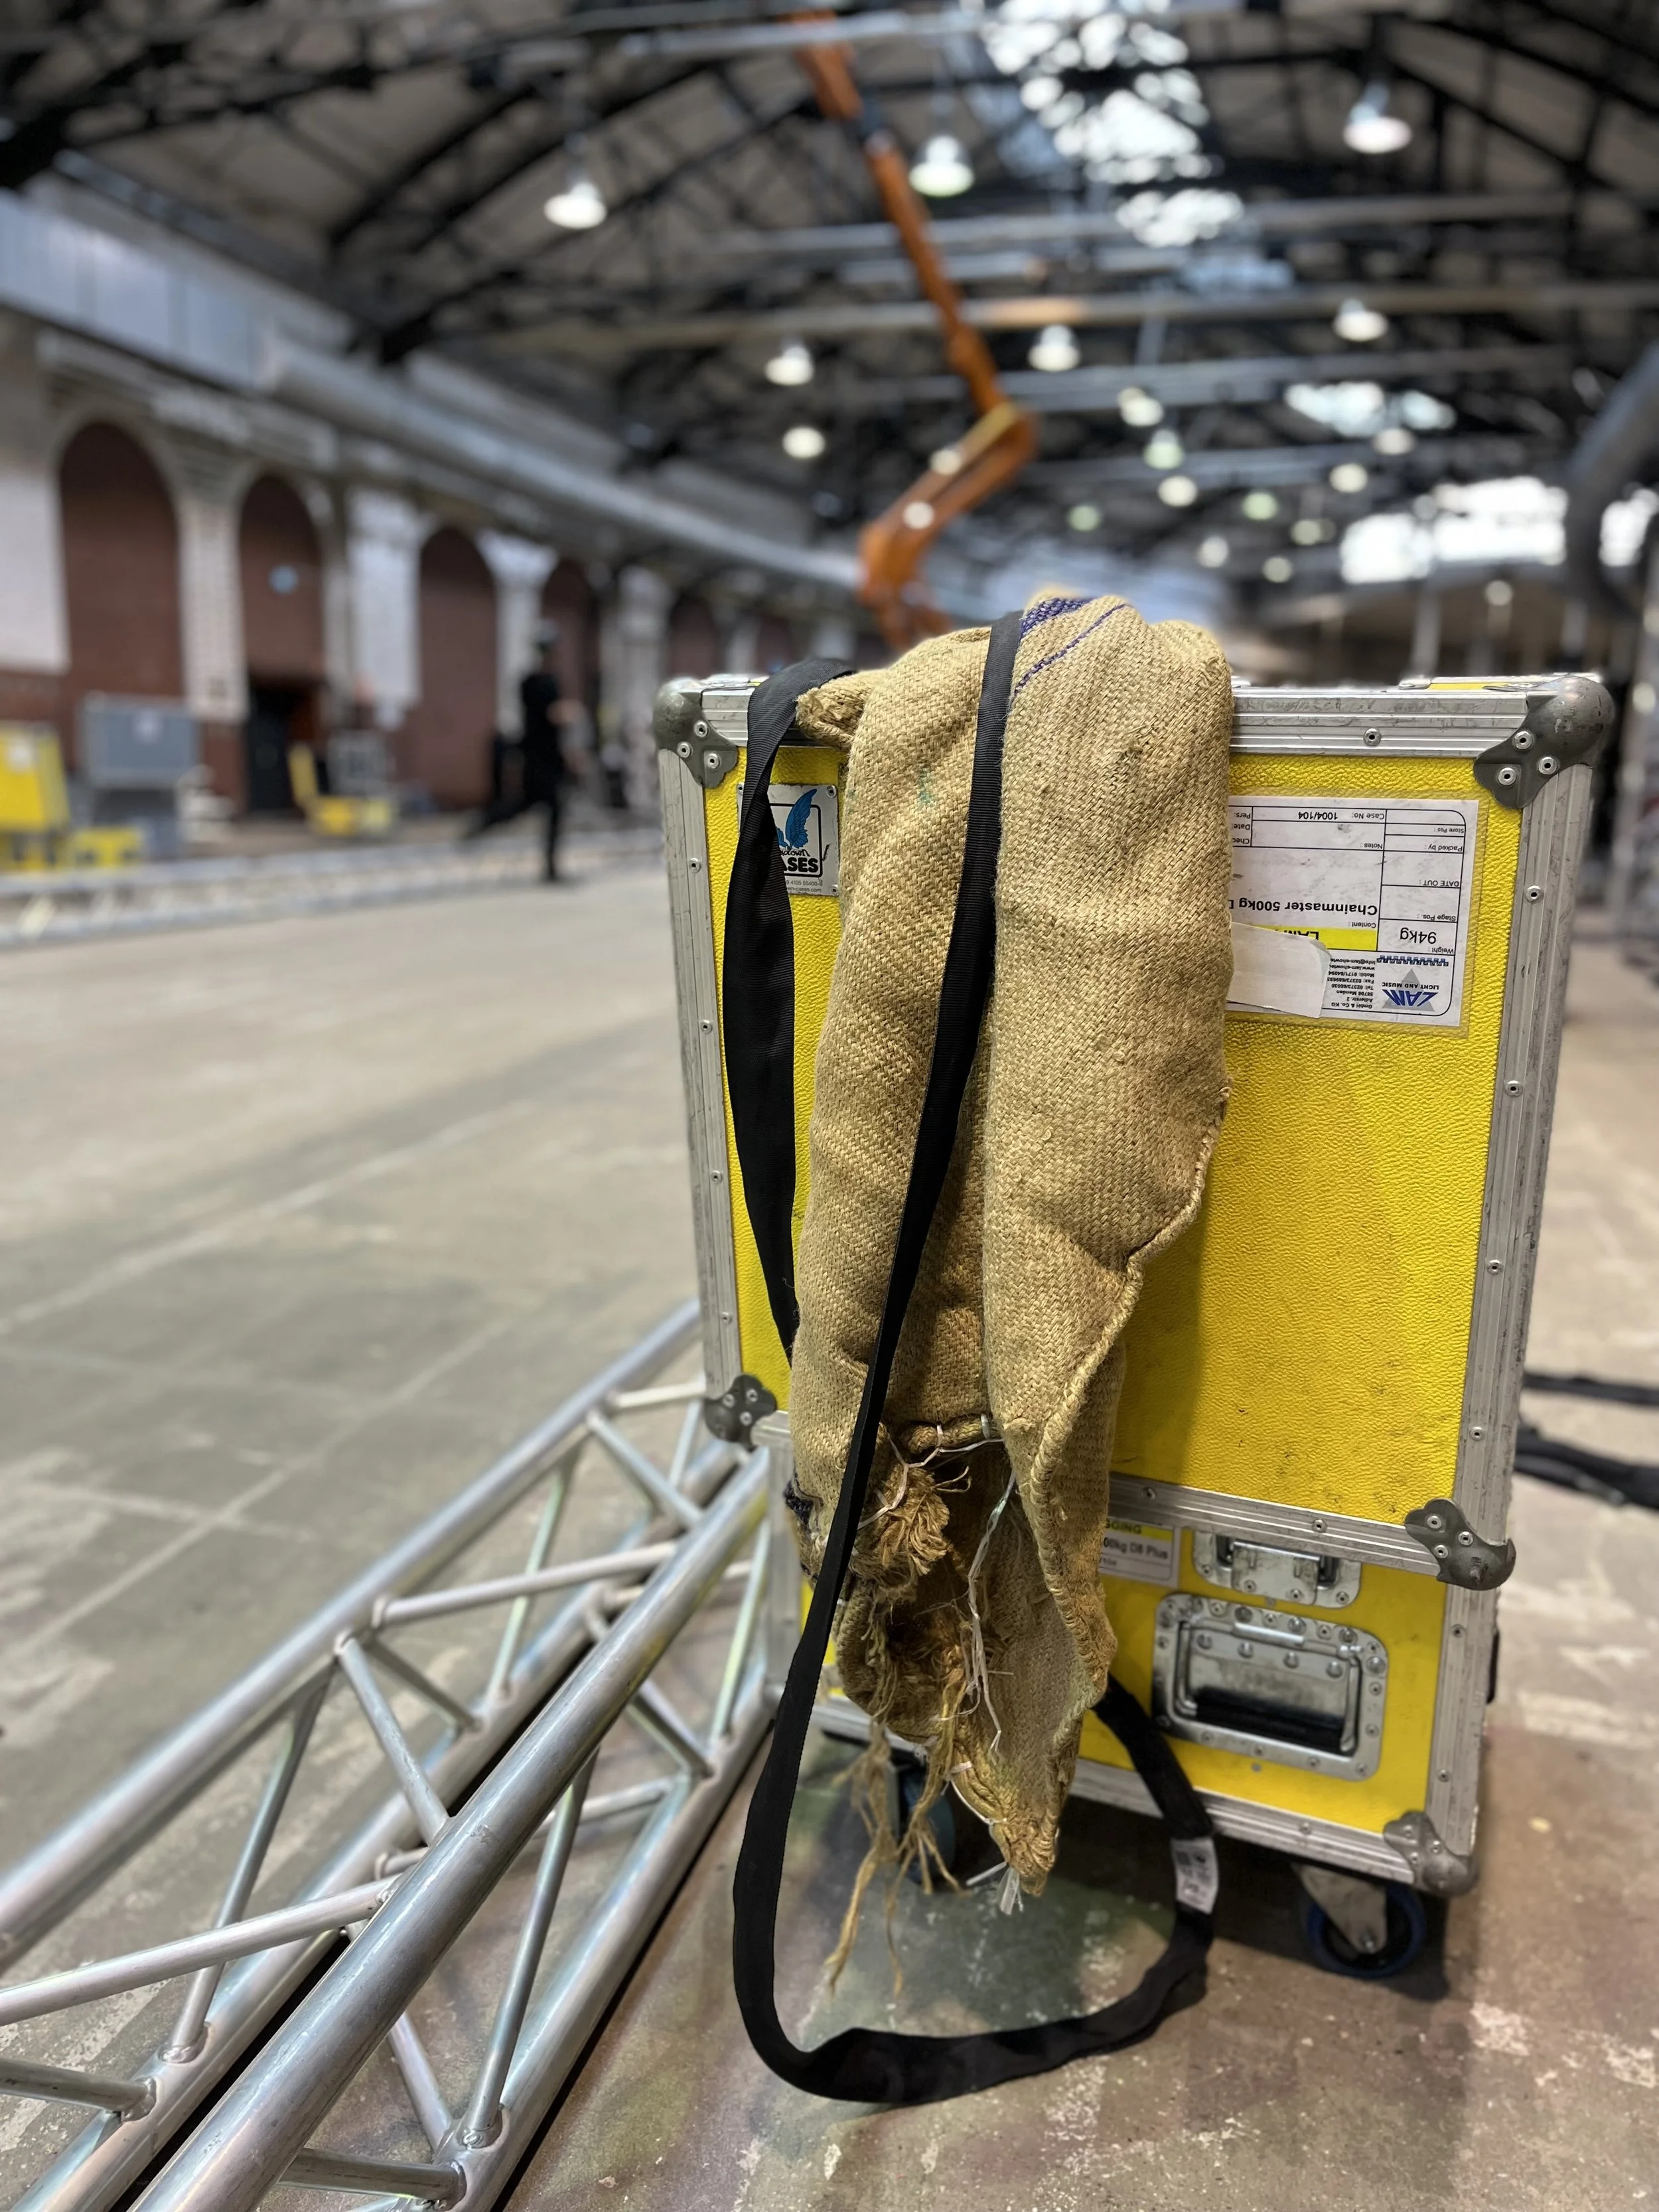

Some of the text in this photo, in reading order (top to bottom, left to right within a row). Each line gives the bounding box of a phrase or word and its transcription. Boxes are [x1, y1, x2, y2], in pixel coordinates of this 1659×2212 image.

[1298, 811, 1338, 820] 1004/104
[1239, 897, 1281, 911] 500kg
[1285, 902, 1378, 915] Chainmaster
[1400, 927, 1437, 944] 94kg
[1382, 989, 1439, 1007] LAM
[1145, 1545, 1168, 1560] Plus
